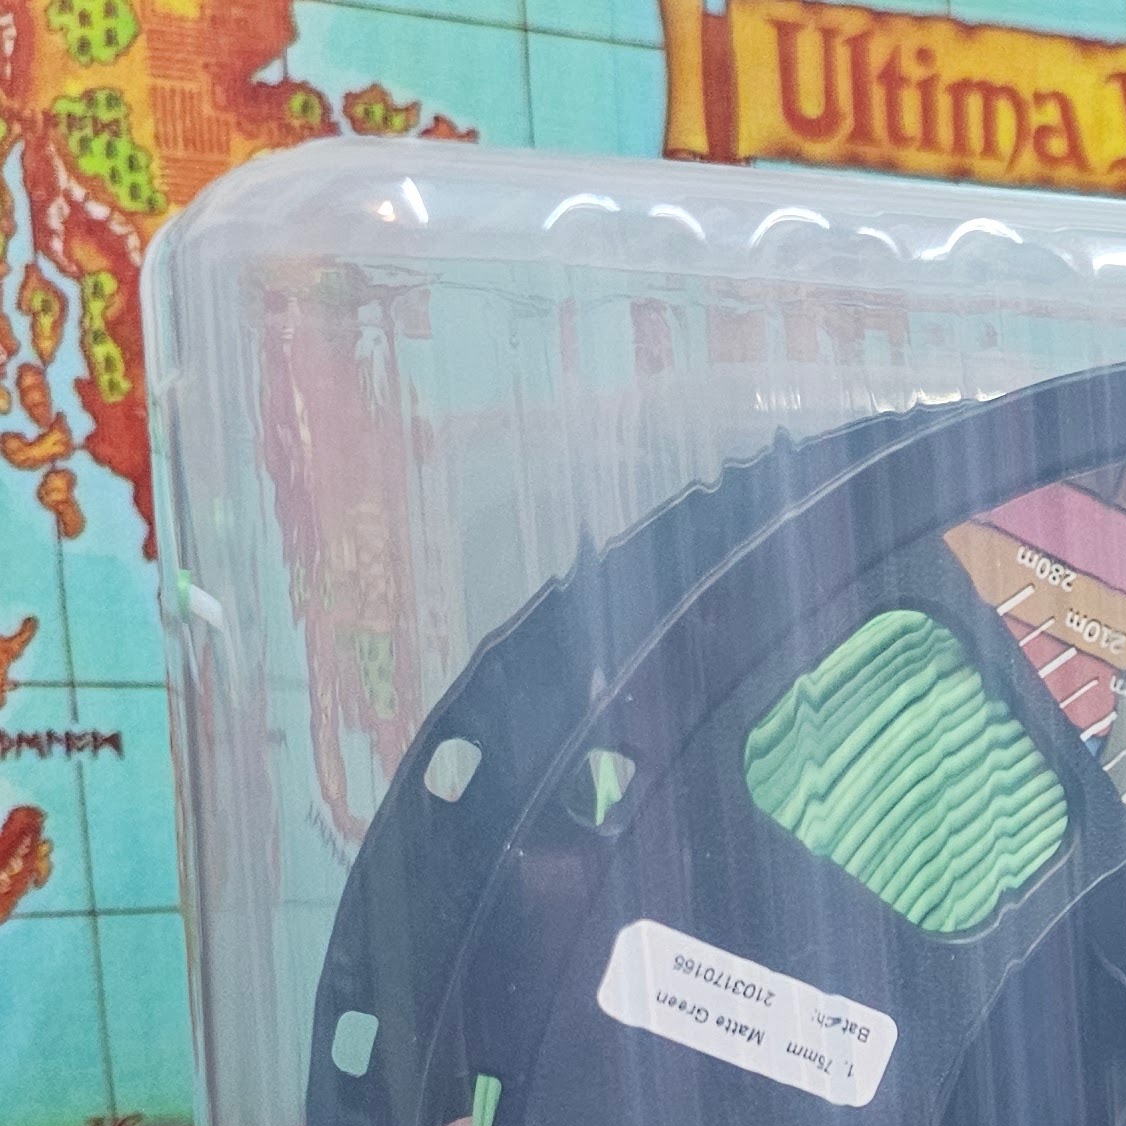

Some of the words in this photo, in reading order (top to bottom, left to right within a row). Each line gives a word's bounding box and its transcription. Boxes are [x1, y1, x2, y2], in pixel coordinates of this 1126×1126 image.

[767, 17, 1090, 175] Ultima
[1016, 545, 1077, 593] 280m
[1065, 608, 1126, 655] 210m
[655, 990, 710, 1024] Green
[716, 1015, 765, 1046] Matte
